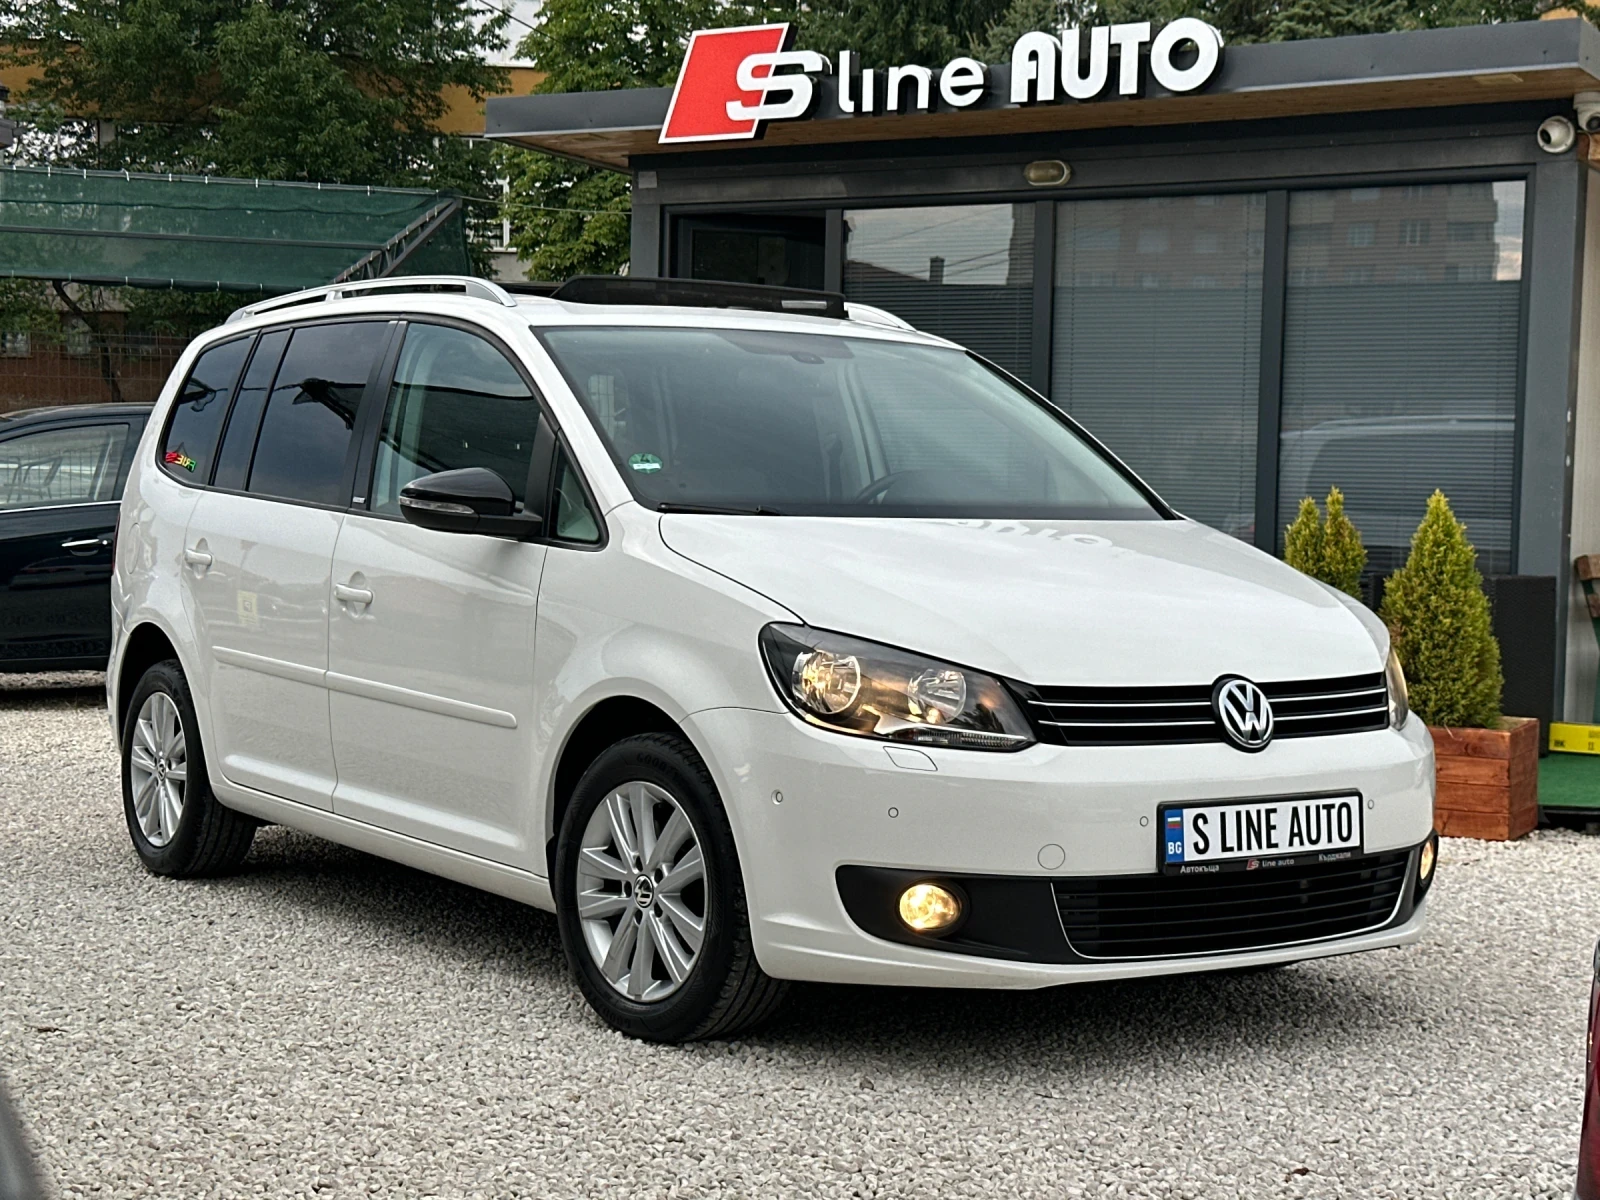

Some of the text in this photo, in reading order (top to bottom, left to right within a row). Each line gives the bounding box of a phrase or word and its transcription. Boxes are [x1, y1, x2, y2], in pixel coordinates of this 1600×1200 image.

[726, 17, 1220, 121] S line AUTO
[1218, 679, 1274, 748] VW
[1192, 802, 1353, 855] S LINE AUTO
[1167, 842, 1182, 855] BG
[1278, 858, 1295, 867] auto
[1180, 864, 1220, 874] Автокъща
